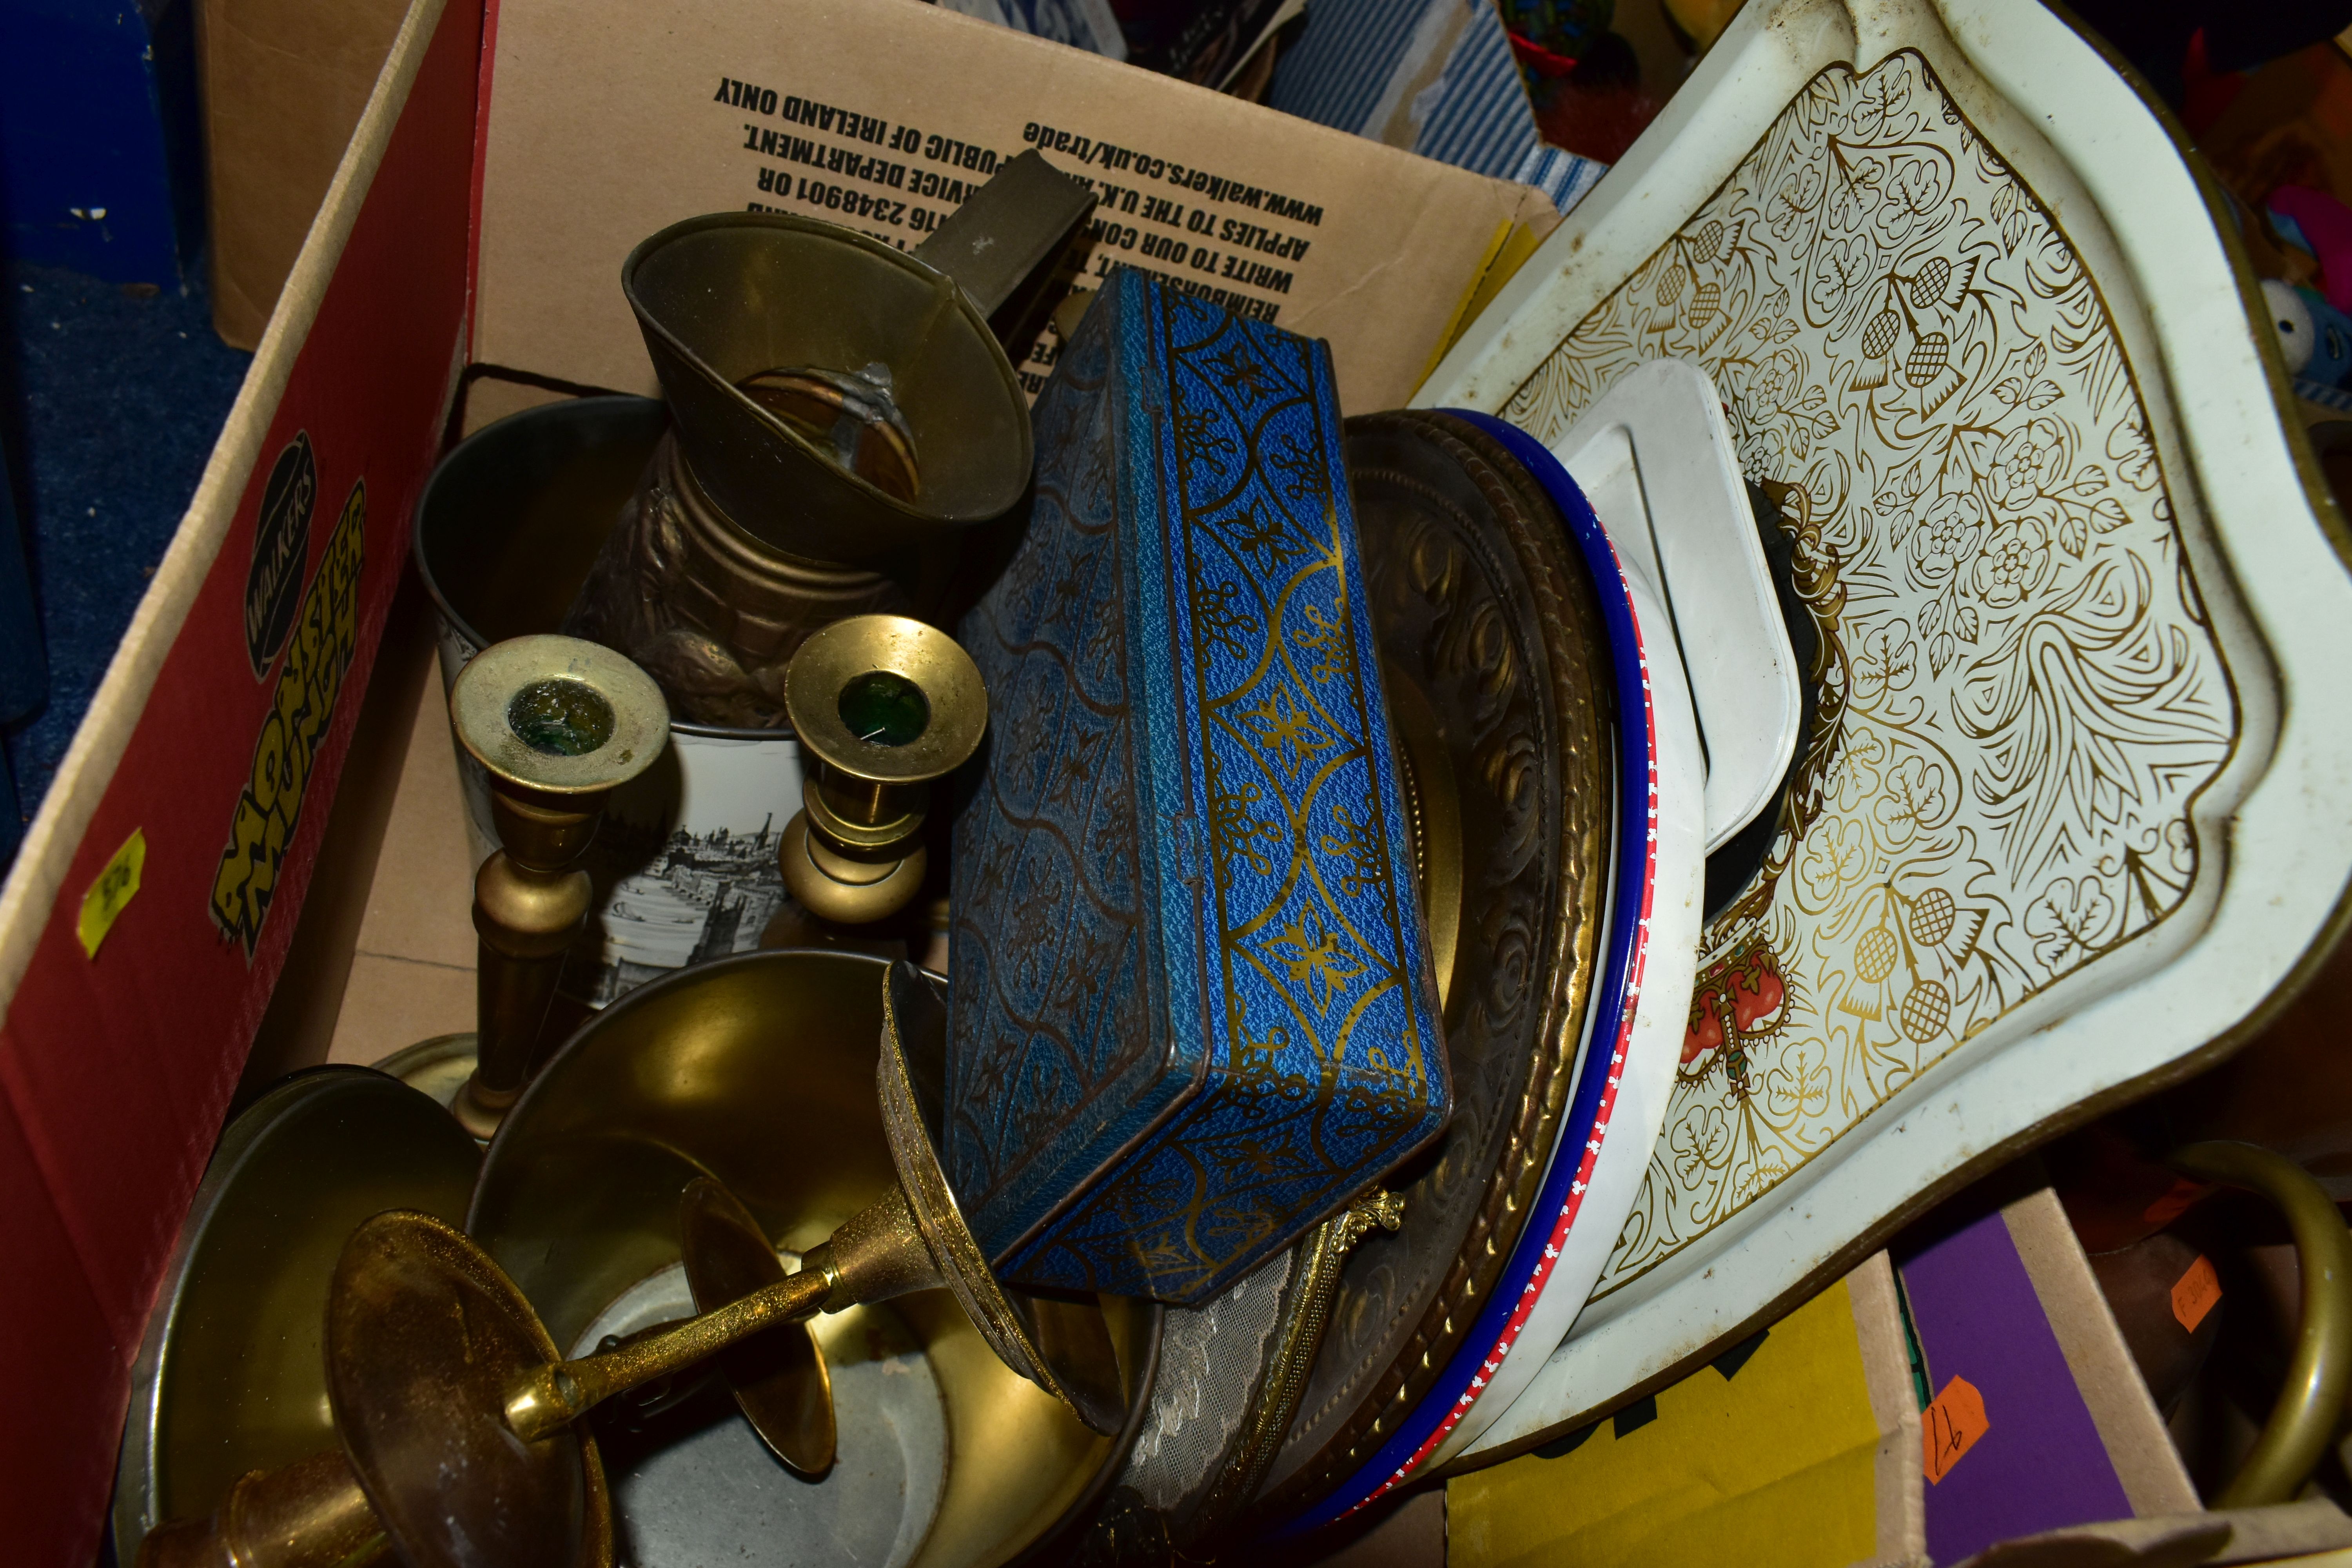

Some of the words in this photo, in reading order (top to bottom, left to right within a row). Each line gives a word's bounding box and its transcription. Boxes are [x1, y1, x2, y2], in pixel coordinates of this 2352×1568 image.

[713, 77, 778, 115] ONLY
[782, 95, 887, 145] IRELAND
[743, 124, 906, 190] DEPARTMENT.
[888, 125, 921, 154] OF
[757, 167, 793, 196] OR
[1023, 122, 1324, 226] www.walkers.co.uk/trade
[796, 178, 907, 225] 2348901
[1098, 181, 1140, 214] U.K.
[1141, 196, 1185, 229] THE
[1186, 209, 1214, 236] TO
[1220, 219, 1310, 262] APPLIES
[1140, 233, 1188, 264] OUR
[1191, 248, 1220, 274] TO
[1221, 256, 1294, 294] WRITE
[247, 457, 312, 645] WALKERS
[212, 481, 364, 932] MONSTER
[241, 570, 358, 958] MUNCH
